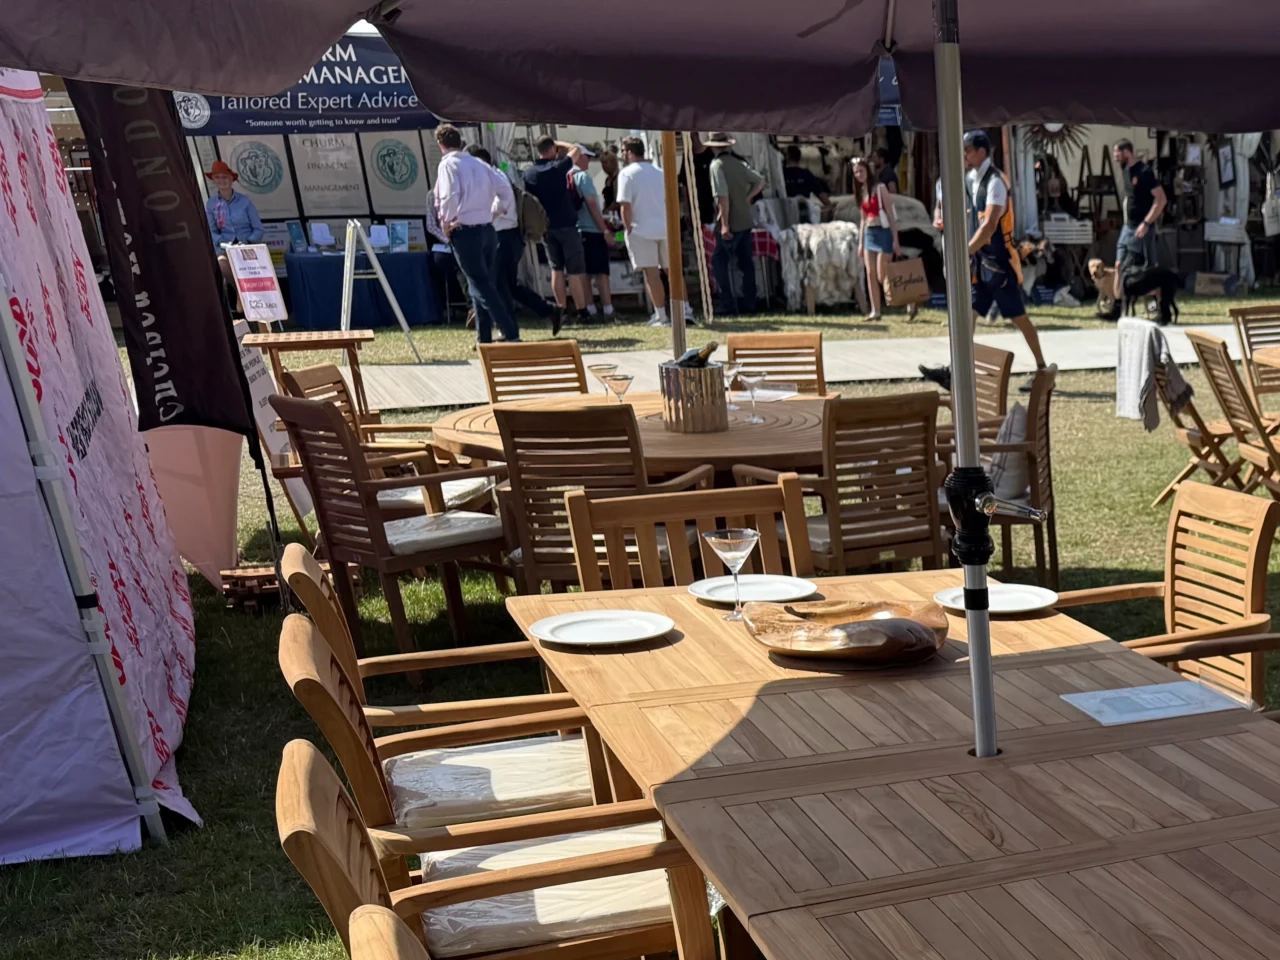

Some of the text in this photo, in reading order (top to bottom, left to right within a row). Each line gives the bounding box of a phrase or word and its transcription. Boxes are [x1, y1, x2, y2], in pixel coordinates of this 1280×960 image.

[321, 43, 357, 62] RM
[298, 65, 413, 85] MANAGE
[221, 91, 419, 114] Tailored Expert Advice
[285, 118, 307, 126] worth
[308, 118, 334, 128] getting
[335, 118, 343, 126] to
[344, 116, 365, 125] know
[366, 116, 381, 125] and
[112, 86, 191, 244] LONDO
